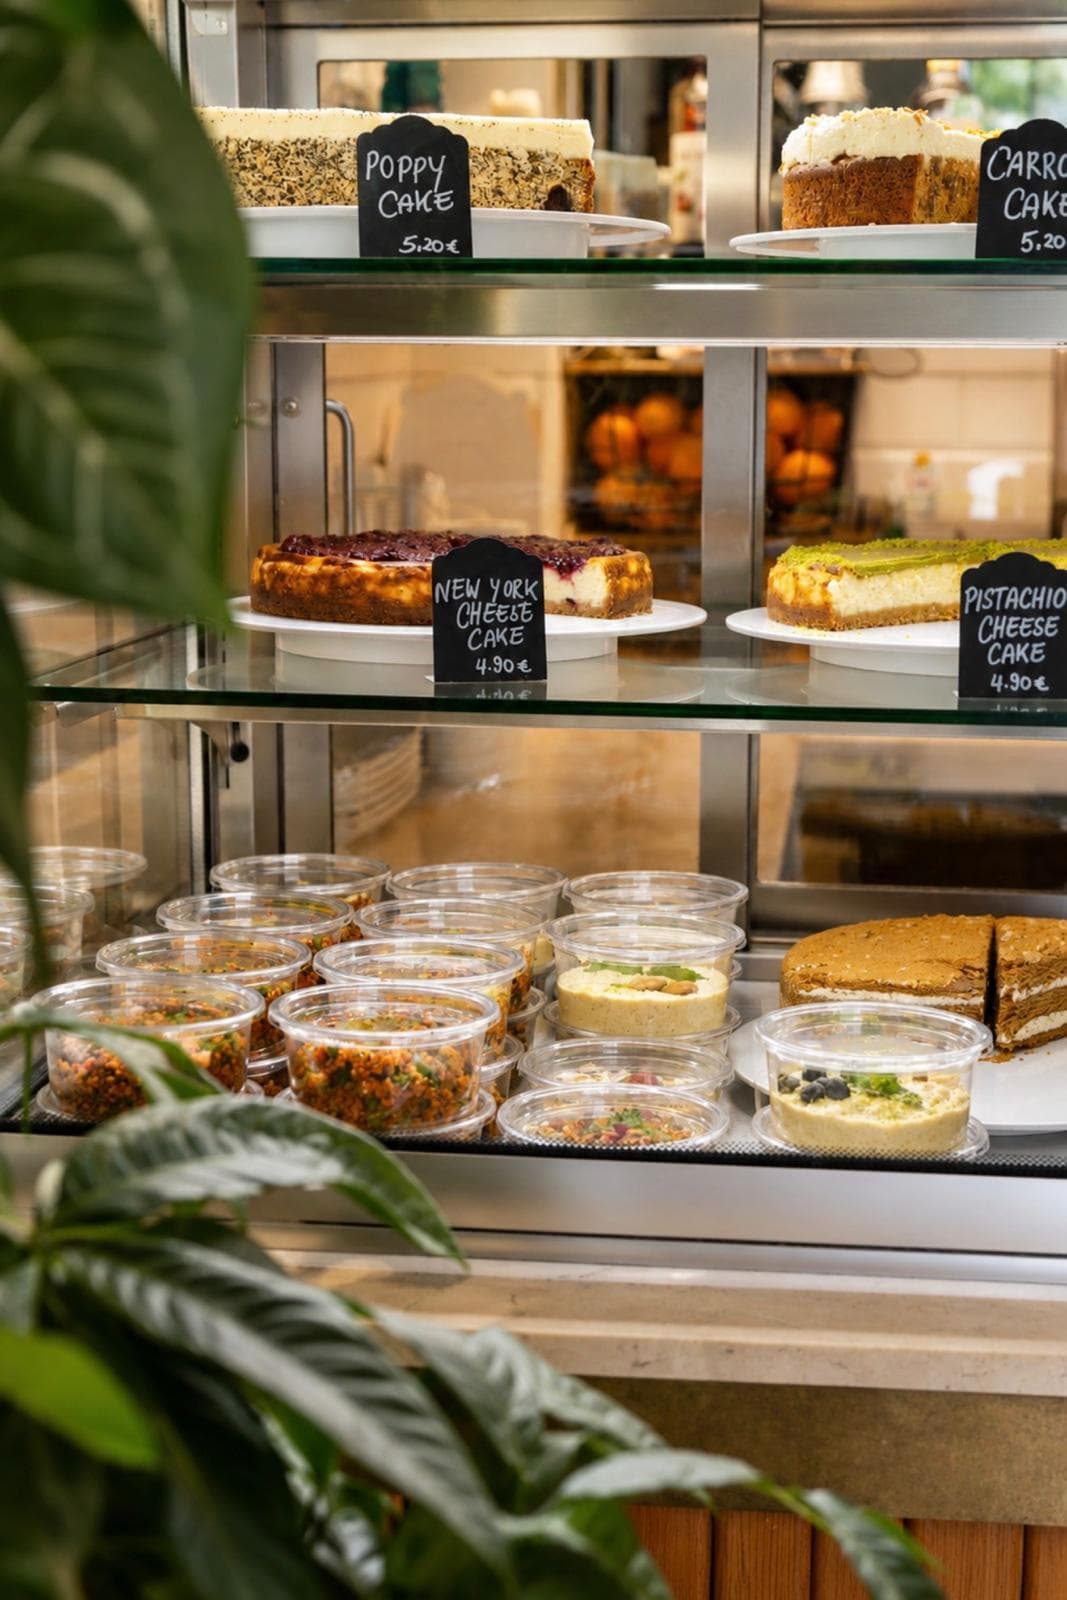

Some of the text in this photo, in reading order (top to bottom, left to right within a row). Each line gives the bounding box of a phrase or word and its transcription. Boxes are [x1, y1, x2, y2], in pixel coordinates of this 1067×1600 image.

[365, 149, 446, 193] POPPY
[378, 190, 454, 218] CAKE
[1020, 230, 1066, 253] 5.20
[434, 577, 539, 604] NEW YORK
[964, 585, 1067, 614] PISTACHIO
[456, 601, 534, 630] CHEESE
[977, 614, 1061, 644] CHEESE
[466, 626, 525, 651] CAKE
[475, 655, 532, 675] 4.90€
[987, 641, 1046, 666] CAKE
[990, 672, 1050, 693] 4.90€
